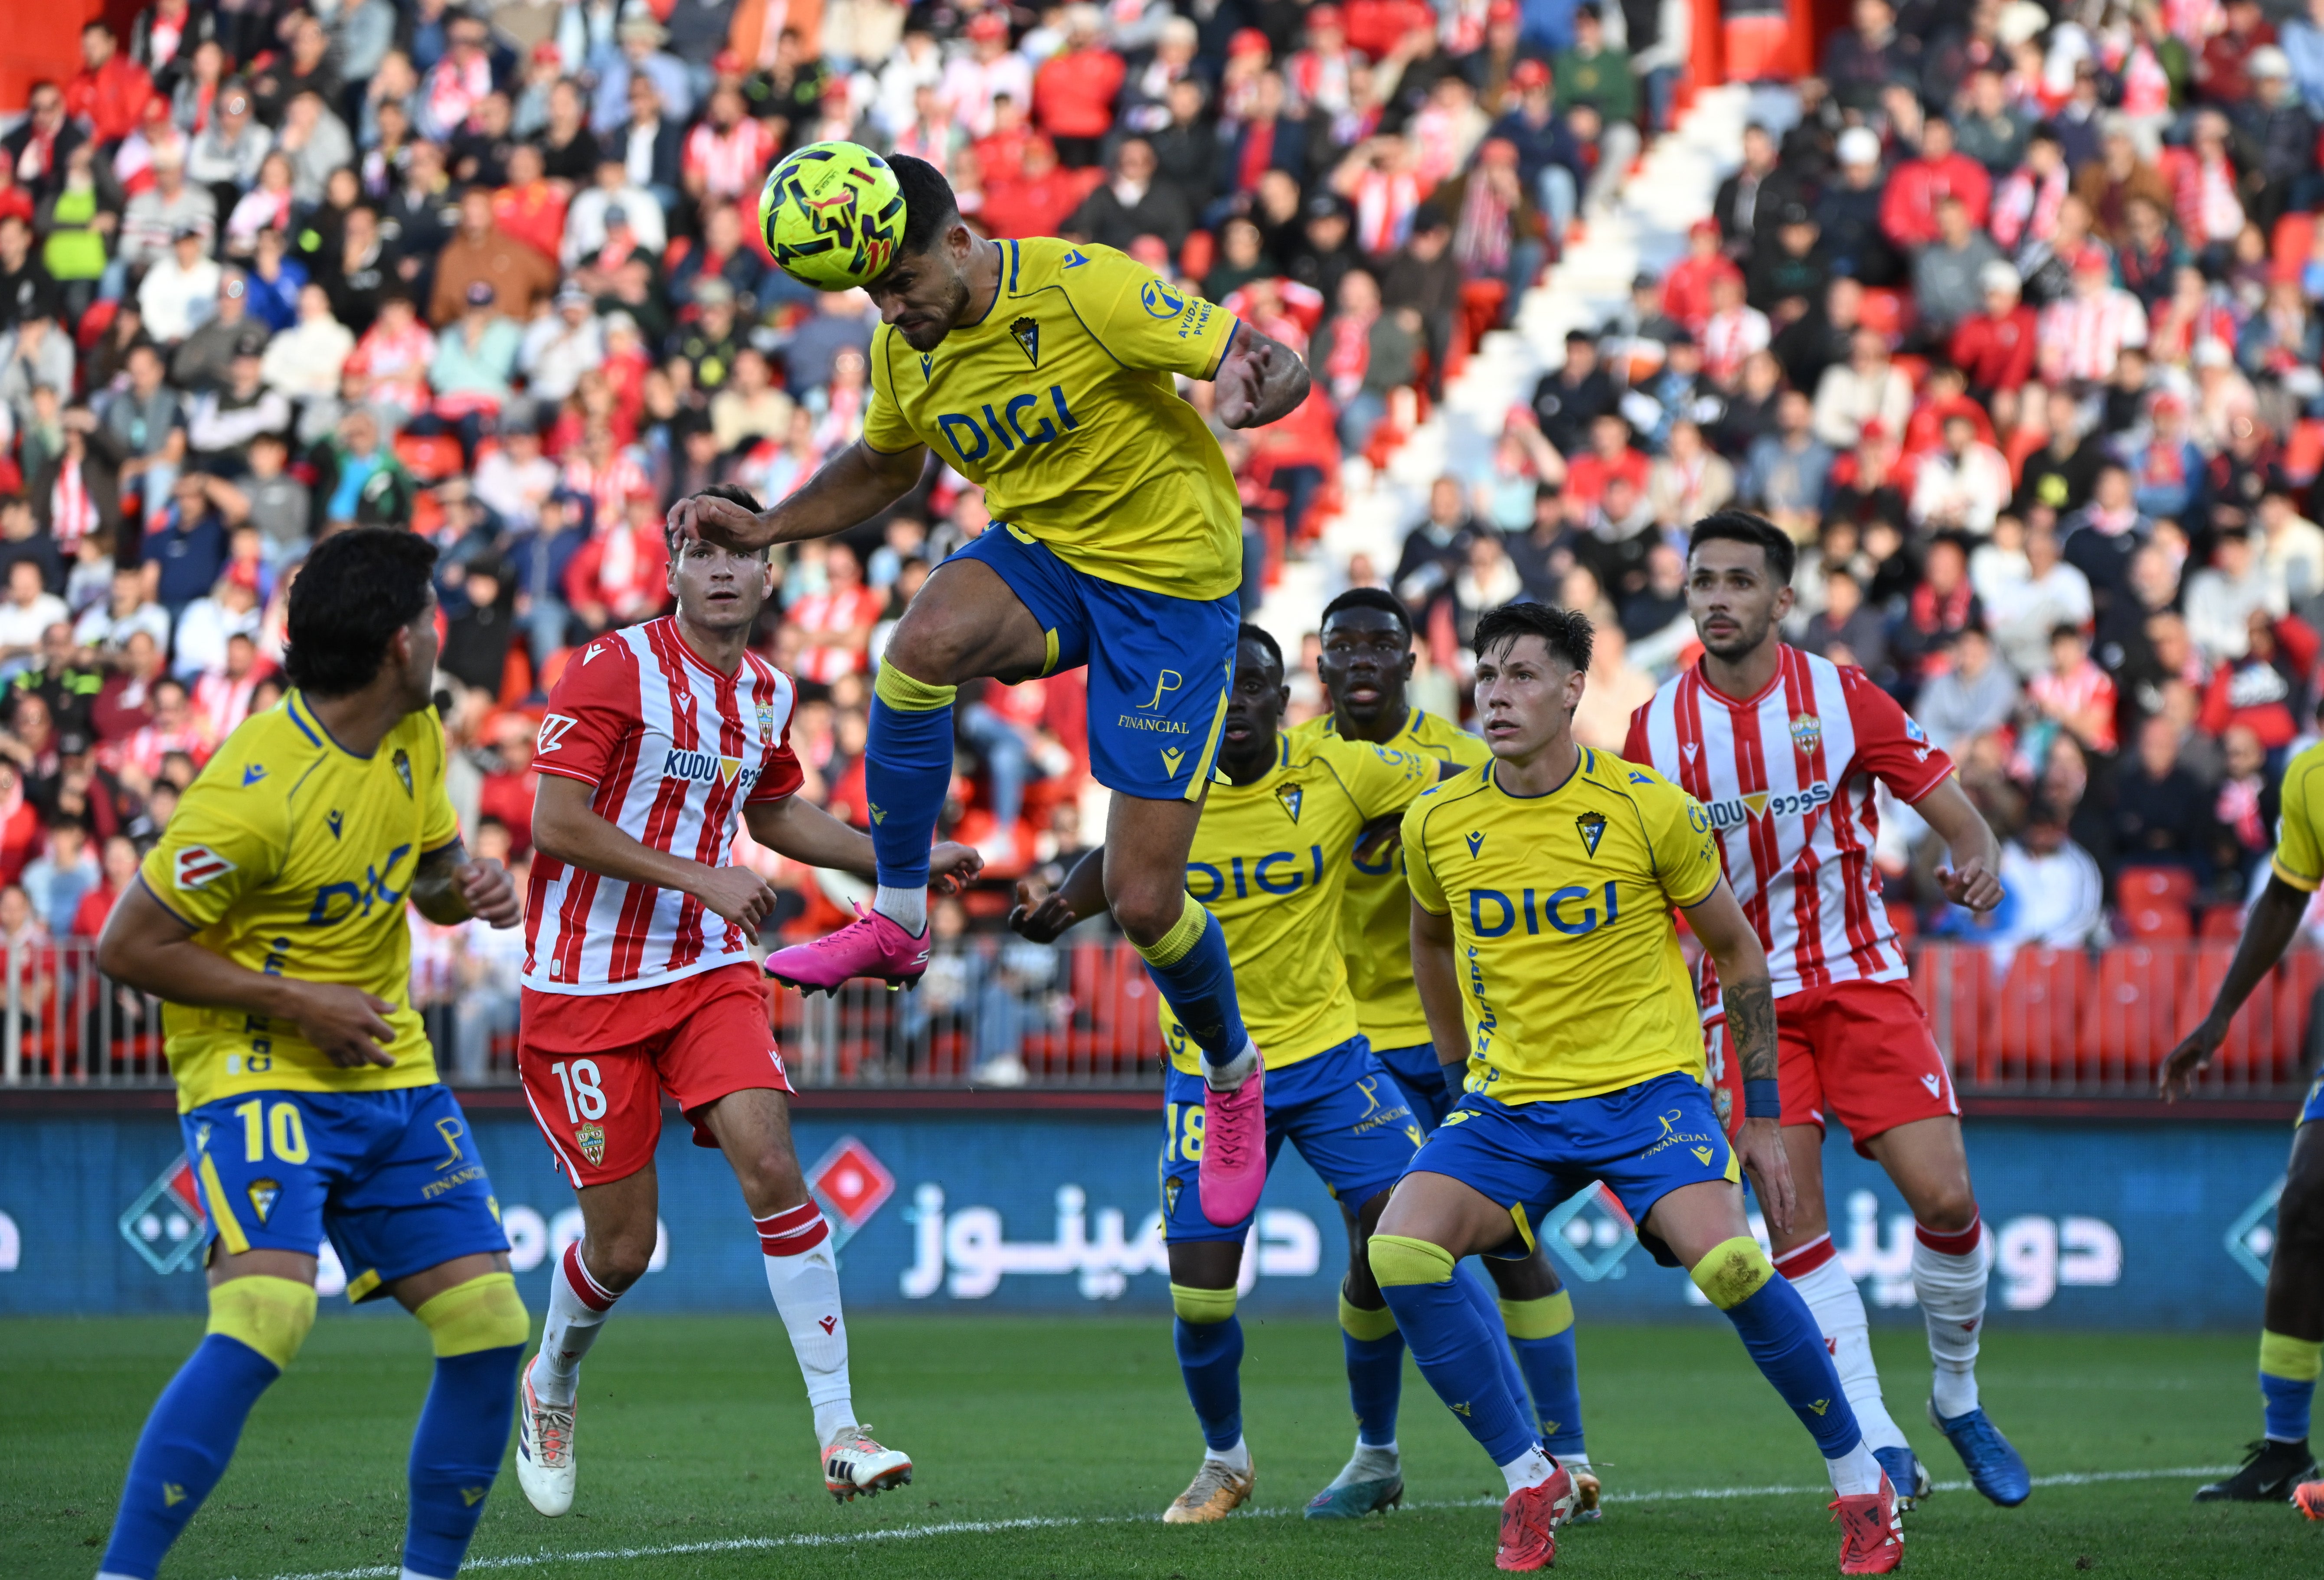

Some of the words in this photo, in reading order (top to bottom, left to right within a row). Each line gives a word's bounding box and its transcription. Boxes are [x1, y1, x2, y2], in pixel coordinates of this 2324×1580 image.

[1178, 300, 1200, 338] AYUDA
[1193, 304, 1212, 335] PYMES
[938, 385, 1079, 463] DIGI
[1118, 715, 1190, 734] FINANCIAL
[663, 750, 718, 781] KUDU
[1184, 845, 1323, 904] DIGI
[1469, 880, 1618, 938] DIGI
[552, 1058, 607, 1124] 18
[234, 1098, 310, 1165] 10
[582, 1139, 602, 1147] ALMERIA
[1167, 1103, 1206, 1162] 18
